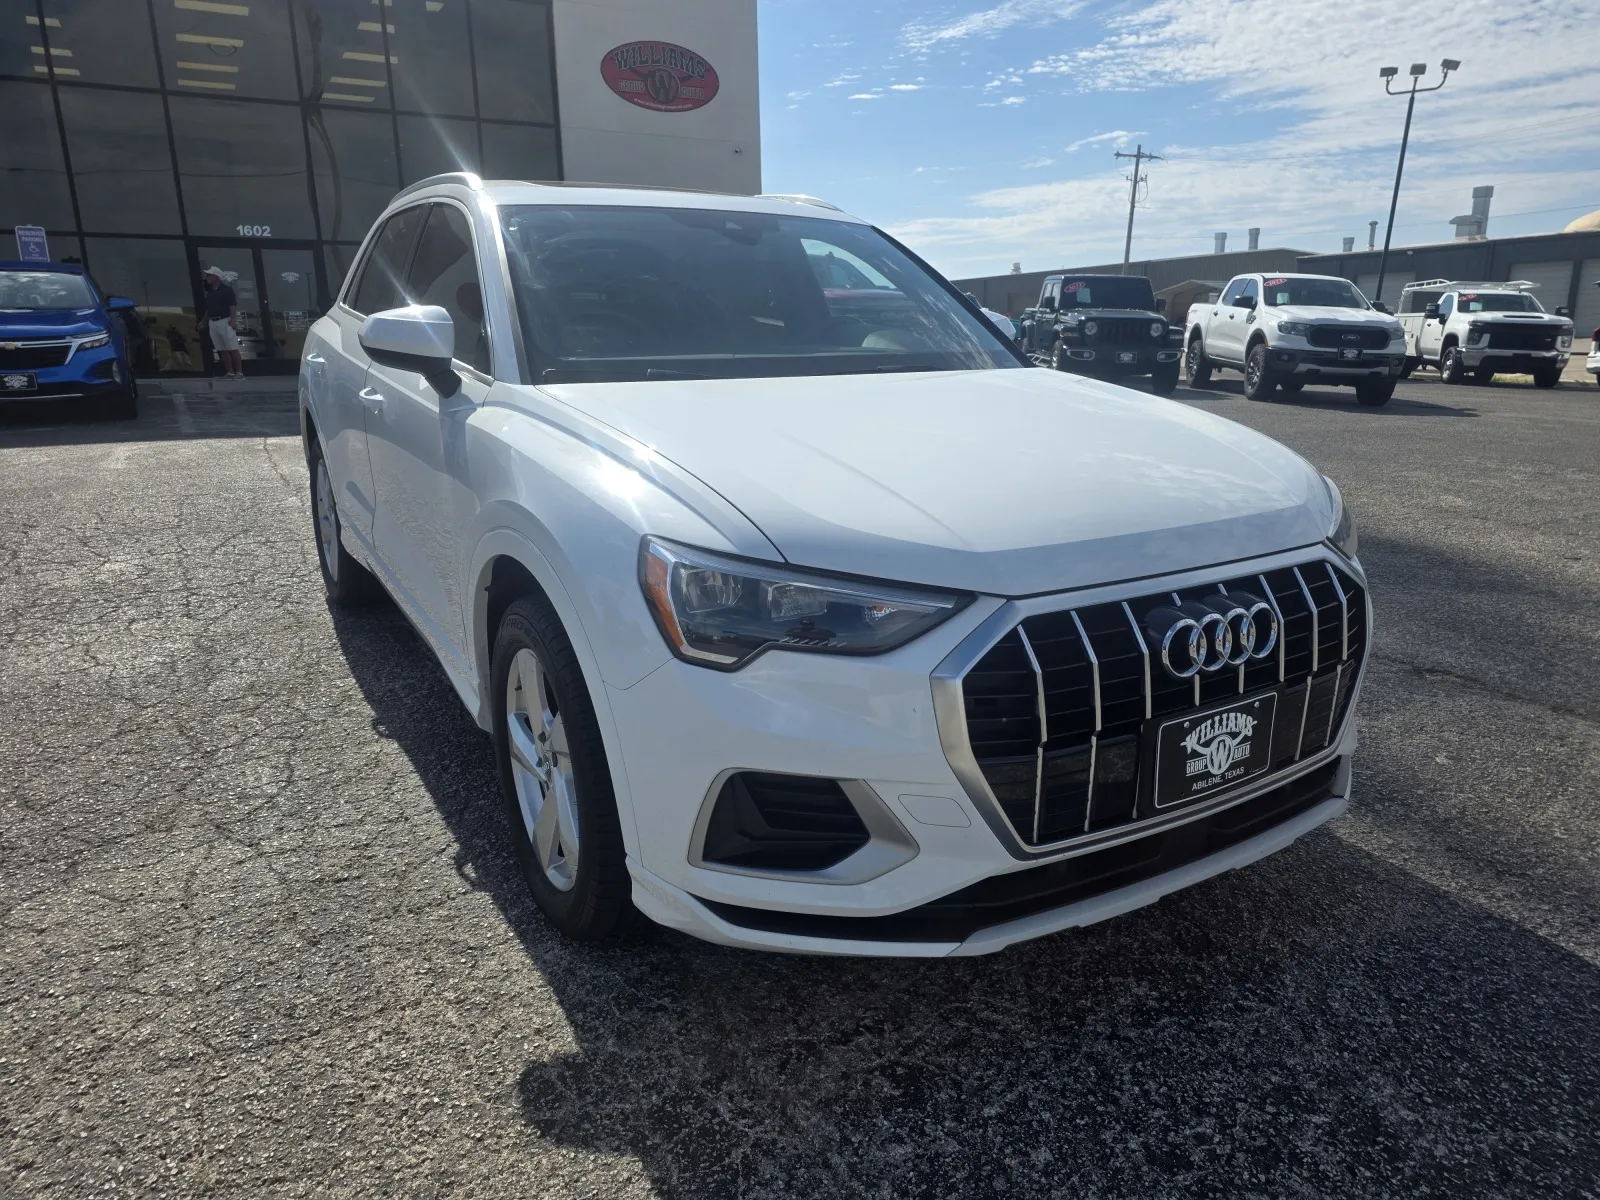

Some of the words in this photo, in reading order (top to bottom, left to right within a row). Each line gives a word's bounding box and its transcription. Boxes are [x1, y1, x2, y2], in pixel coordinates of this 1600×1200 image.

[615, 44, 705, 80] WILLIAMS
[620, 80, 645, 93] GROUP
[681, 86, 705, 100] AUTO
[236, 225, 271, 237] 1602
[1185, 712, 1254, 755] WILLIAMS
[1186, 758, 1207, 774] GROUP
[1234, 744, 1250, 760] AUTO
[1192, 774, 1224, 792] ABILENE,
[1225, 766, 1245, 780] TEXAS
